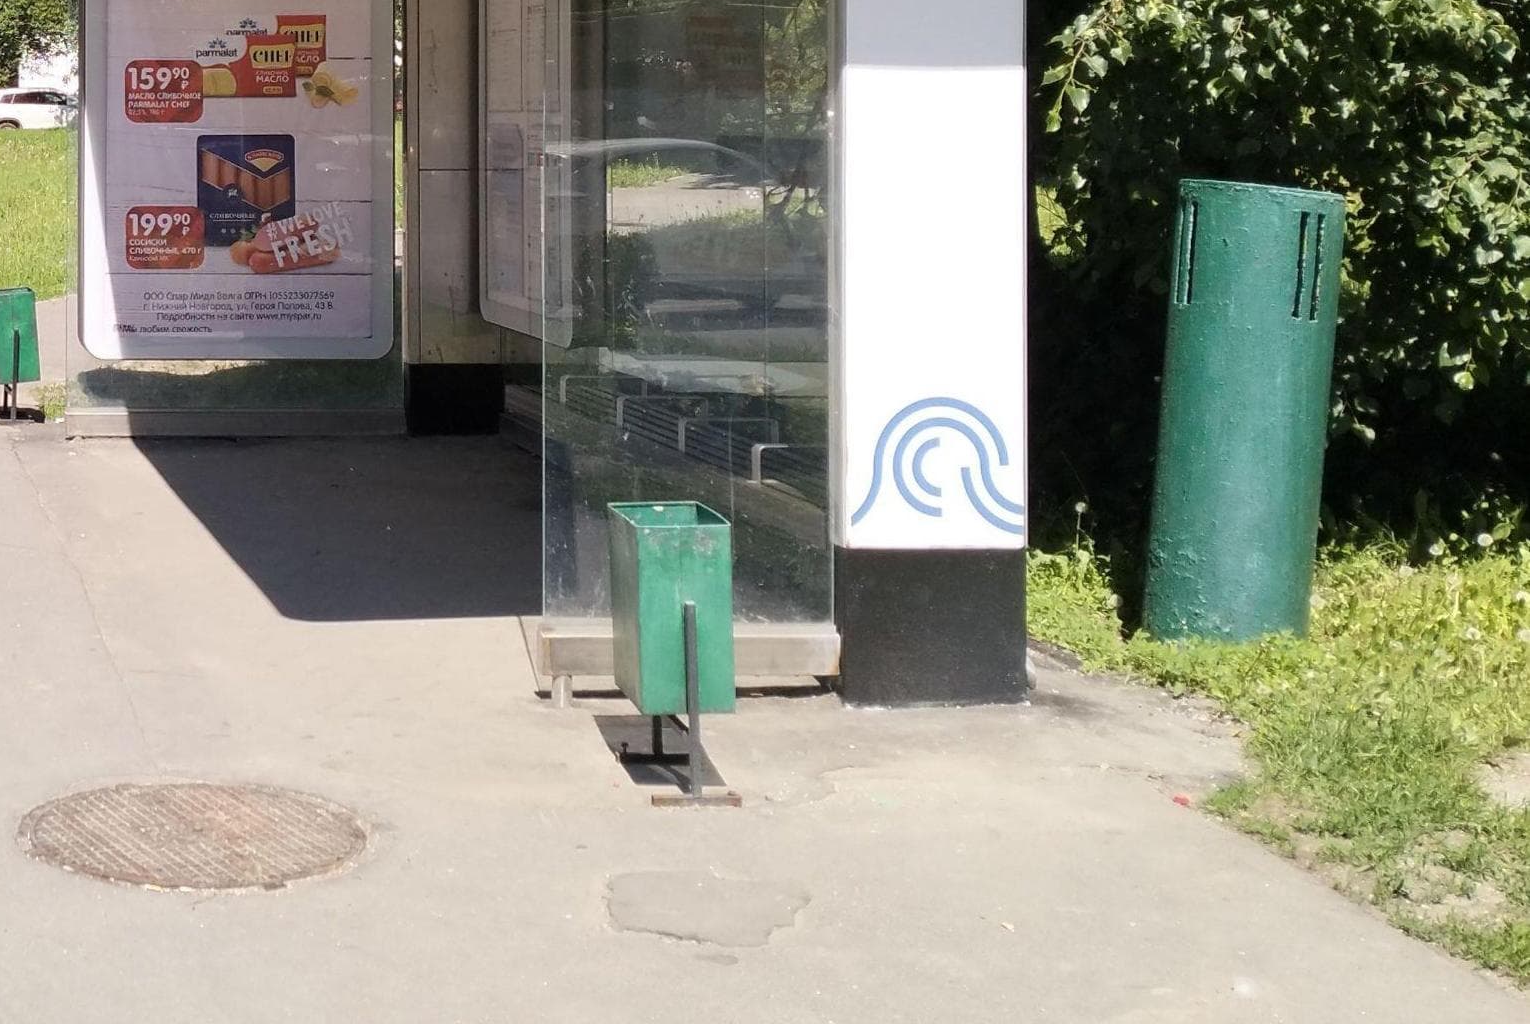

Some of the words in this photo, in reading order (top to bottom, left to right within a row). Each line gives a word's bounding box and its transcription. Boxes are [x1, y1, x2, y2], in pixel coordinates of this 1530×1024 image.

[196, 48, 238, 59] parmalat
[128, 67, 172, 90] 159
[173, 67, 190, 79] 90
[256, 75, 290, 83] МАСЛО
[128, 92, 156, 100] МАСЛО
[157, 92, 201, 100] СЛИВОЧНОЕ
[128, 100, 170, 108] PARMALAT
[171, 100, 190, 108] CHEF
[129, 213, 173, 236] 199
[173, 213, 190, 225] 90
[129, 238, 168, 246] СОСИСКИ
[271, 217, 355, 268] FRESH
[143, 291, 165, 301] ООО
[166, 291, 189, 303] Спар
[190, 291, 215, 301] Мидл
[217, 291, 243, 301] Волга
[244, 291, 267, 300] ОГРН
[151, 302, 187, 311] Нижний
[250, 301, 276, 311] Героя
[315, 301, 325, 310] 43
[156, 312, 215, 322] Подробности
[229, 313, 255, 321] сайте
[140, 325, 169, 333] любим
